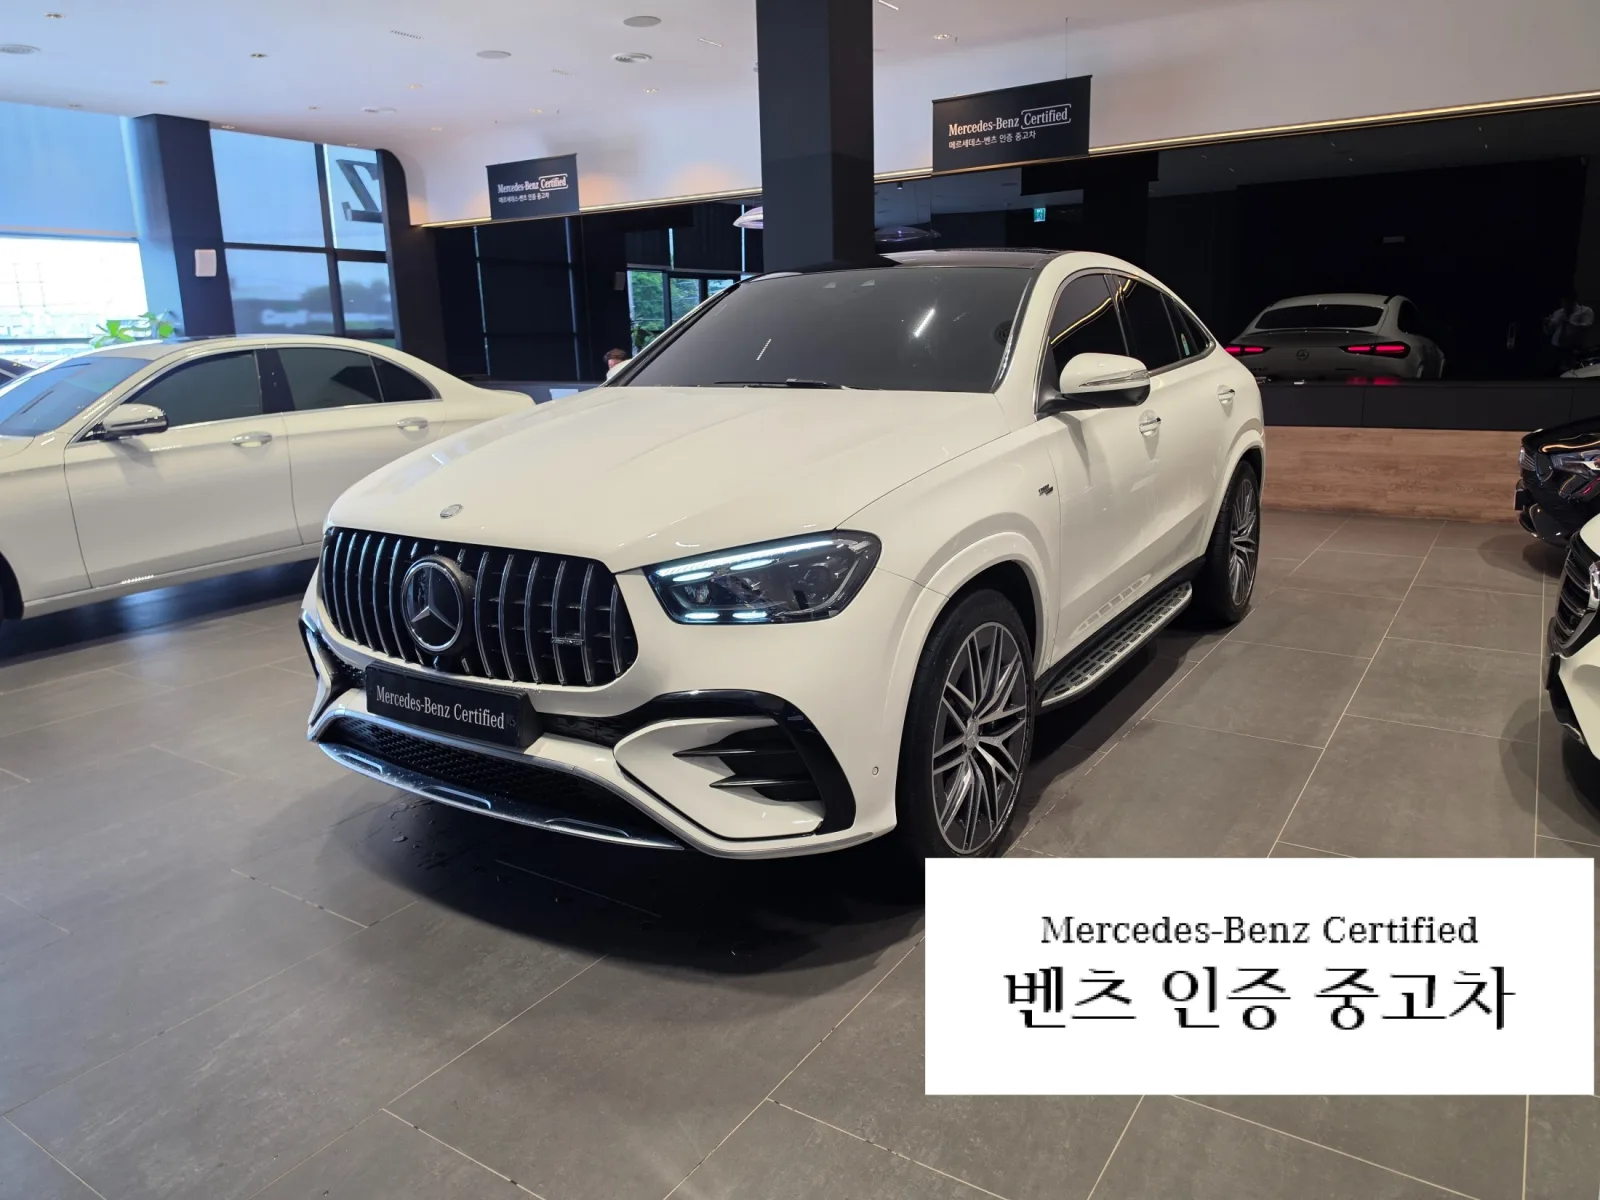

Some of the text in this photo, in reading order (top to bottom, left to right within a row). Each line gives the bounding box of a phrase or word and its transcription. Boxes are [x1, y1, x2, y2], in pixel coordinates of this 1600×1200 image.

[948, 107, 1068, 137] Mercedes-Benz Certified
[948, 129, 1037, 150] 메르세데스-벤츠 인증 중고차
[497, 176, 567, 194] Mercedes-Benz Certified
[376, 684, 505, 730] Mercedes-Benz Certified
